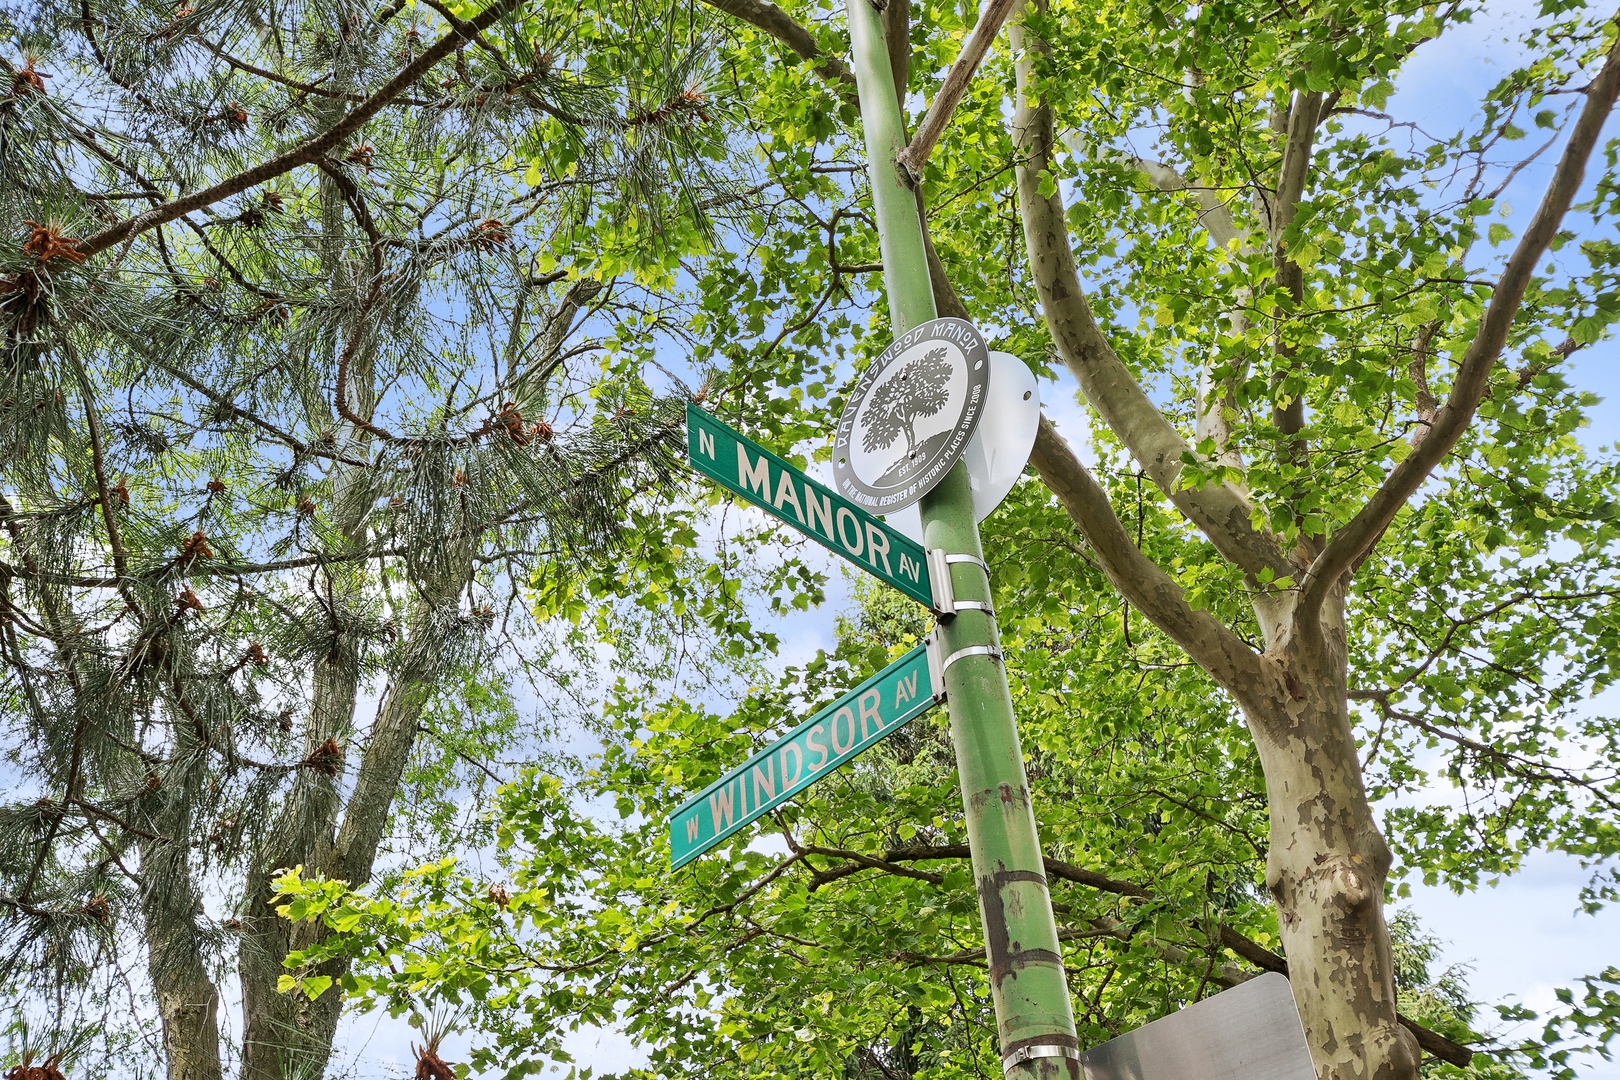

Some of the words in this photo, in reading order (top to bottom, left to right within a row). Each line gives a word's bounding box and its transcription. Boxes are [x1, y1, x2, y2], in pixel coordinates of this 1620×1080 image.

[837, 327, 925, 449] RAVENSWOOD
[930, 322, 979, 356] MANOR
[699, 428, 715, 460] N
[736, 440, 892, 578] MANOR
[899, 553, 920, 584] AV
[847, 484, 858, 499] THE
[854, 491, 878, 507] NATIONAL
[879, 489, 908, 506] REGISTER
[908, 483, 917, 495] OF
[918, 458, 946, 488] HISTORIC
[944, 430, 966, 460] PLACES
[961, 406, 976, 429] SINCE
[898, 464, 911, 477] EST.
[911, 452, 926, 468] 1909
[686, 813, 699, 844] W
[709, 687, 885, 836] WINDSOR
[894, 669, 918, 709] AV
